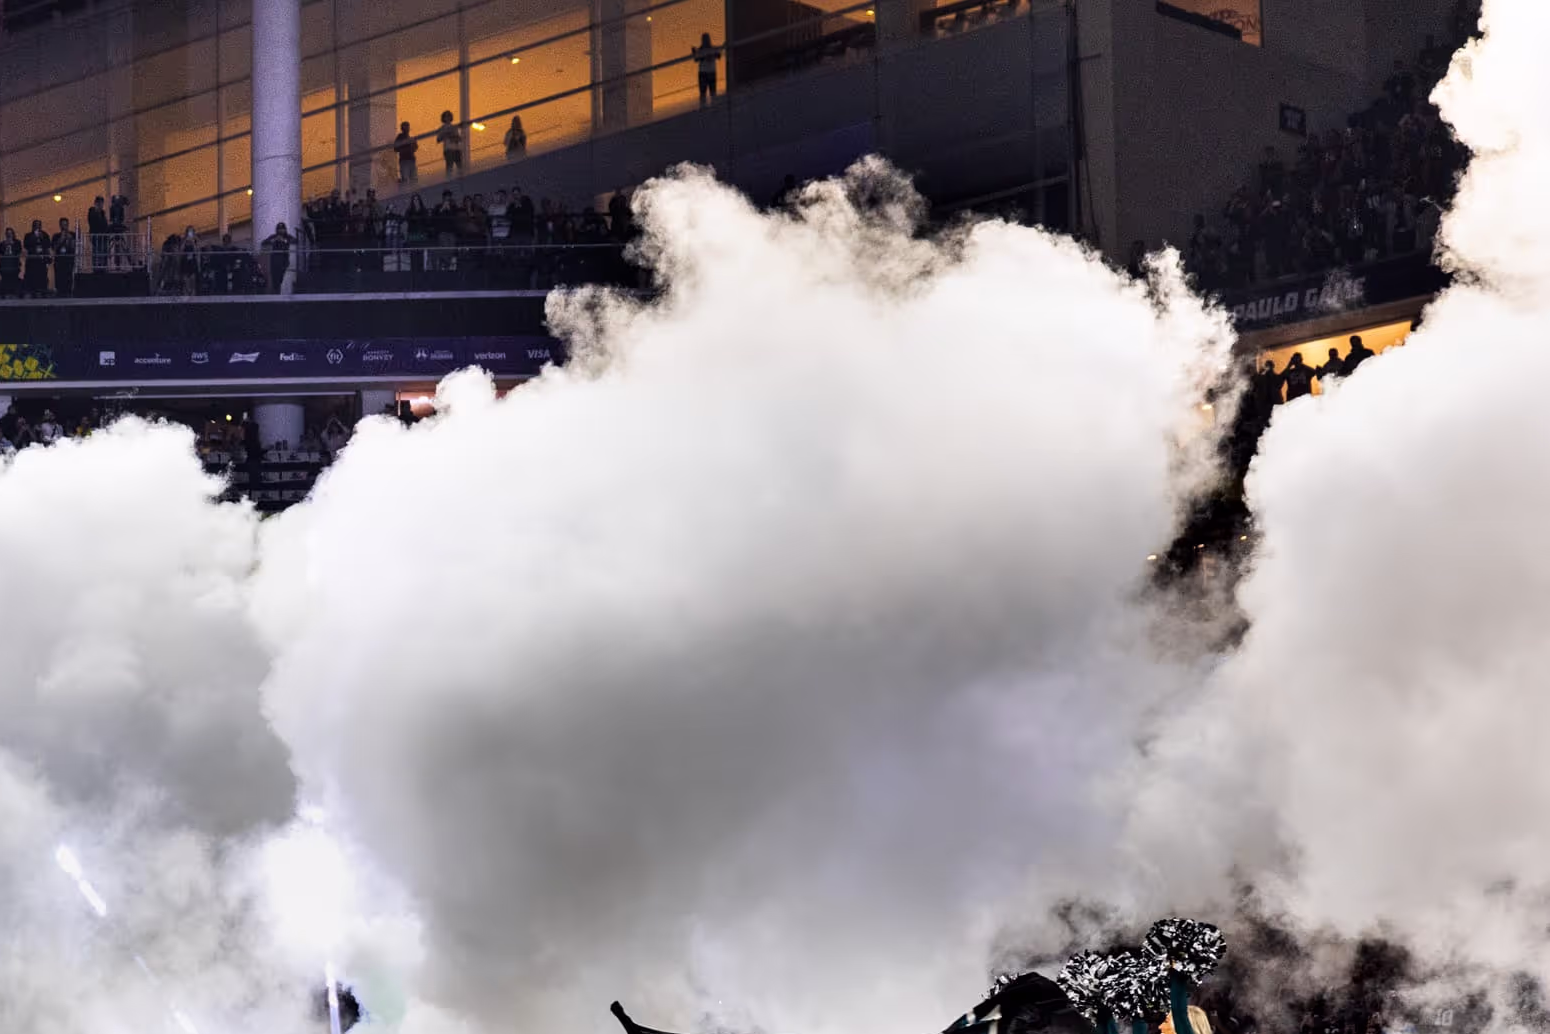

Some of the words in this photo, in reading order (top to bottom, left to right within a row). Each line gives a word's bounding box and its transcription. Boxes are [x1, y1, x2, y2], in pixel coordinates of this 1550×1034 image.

[1233, 291, 1299, 320] PAULO
[474, 351, 506, 360] verizon
[528, 350, 550, 358] VISA
[134, 355, 171, 364] accenture
